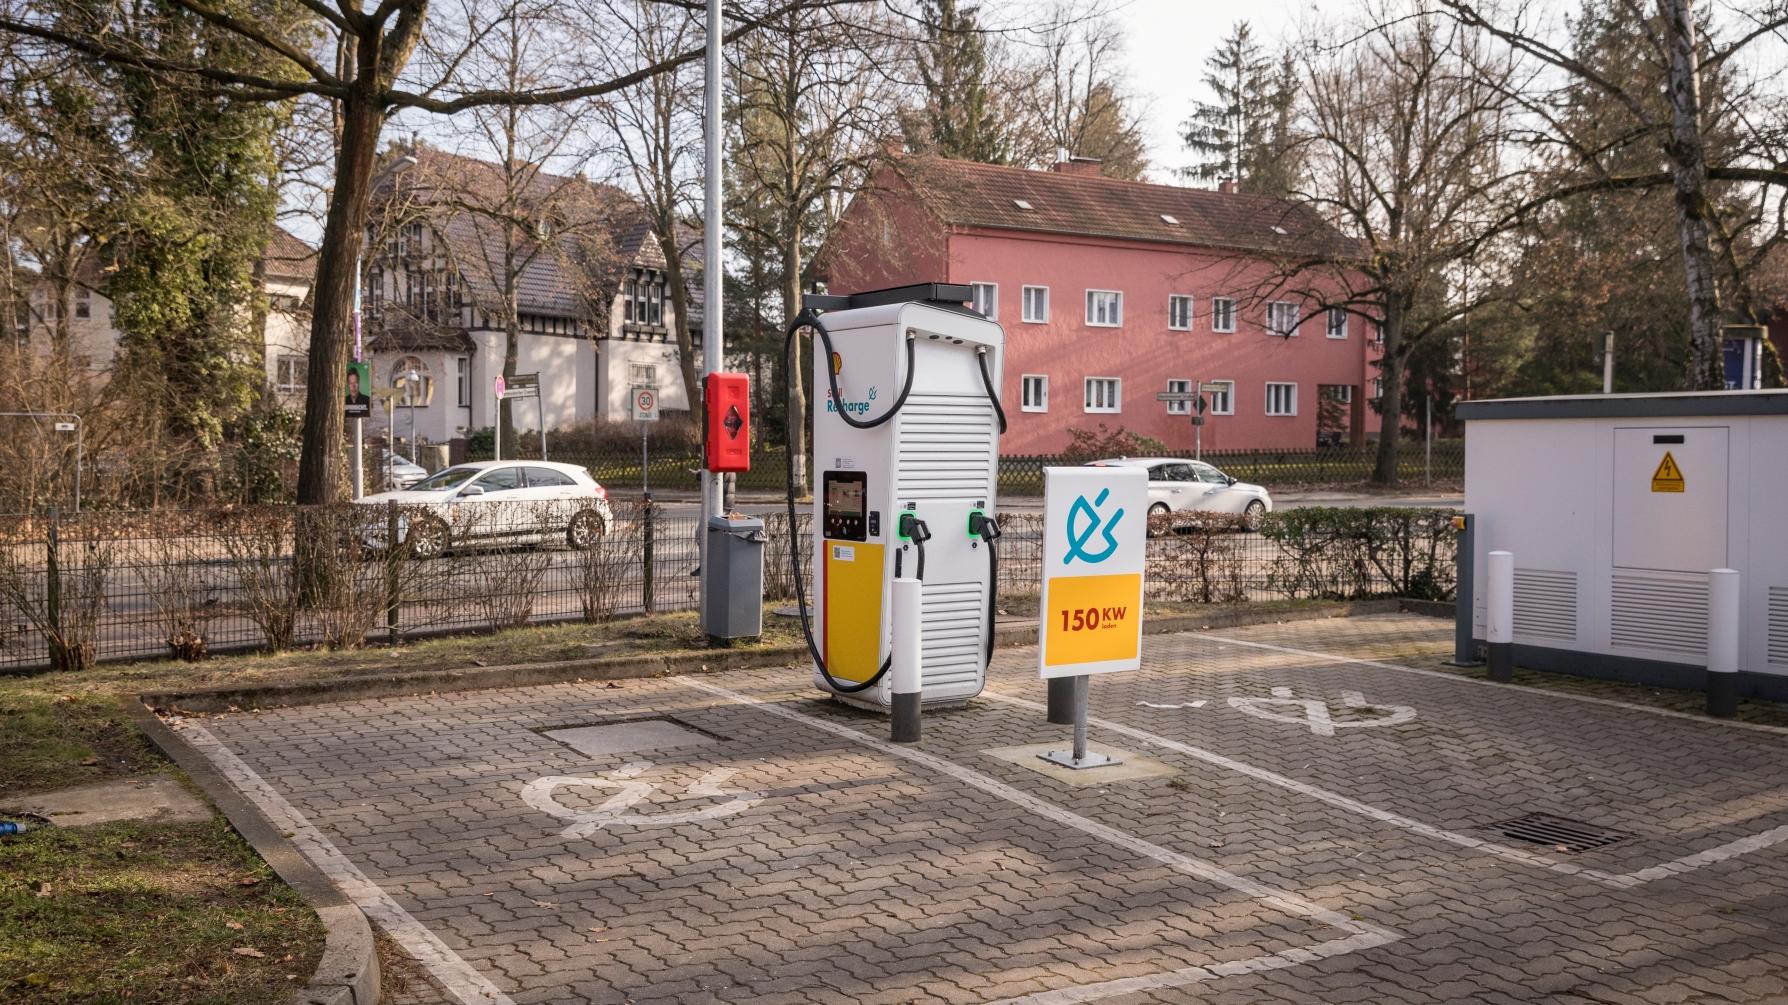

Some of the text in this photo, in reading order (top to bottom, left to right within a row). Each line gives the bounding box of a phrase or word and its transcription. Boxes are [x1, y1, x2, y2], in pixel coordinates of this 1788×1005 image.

[827, 387, 843, 398] Sll
[641, 396, 651, 406] 30
[827, 398, 870, 415] Reharge
[1061, 606, 1127, 632] 150 KW
